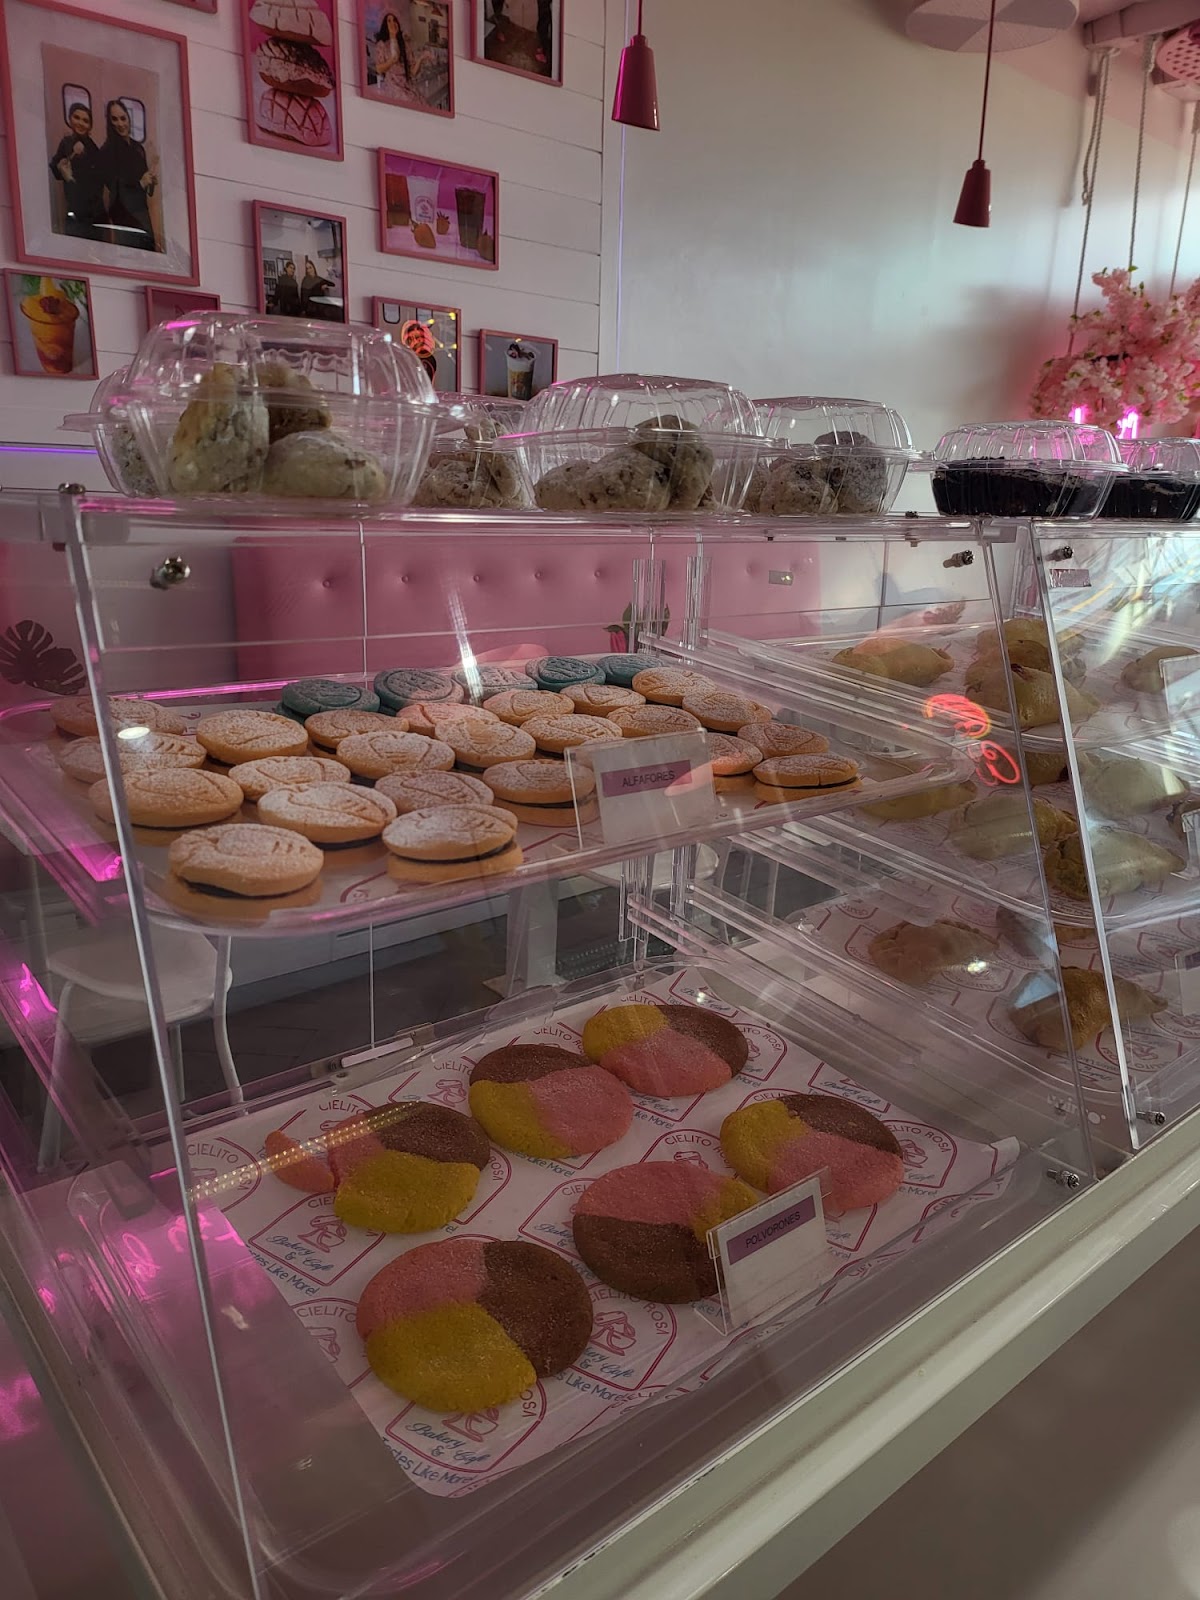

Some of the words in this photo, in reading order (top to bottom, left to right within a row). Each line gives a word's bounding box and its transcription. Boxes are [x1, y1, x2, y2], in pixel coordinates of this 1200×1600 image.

[622, 770, 676, 788] ALFAFORES
[664, 1133, 712, 1147] CIELITO
[924, 1131, 953, 1153] ROSA
[186, 1142, 240, 1164] CIELITO
[546, 1159, 576, 1178] More!
[744, 1210, 801, 1249] POLVORONES
[265, 1234, 317, 1257] Bakery
[284, 1250, 298, 1261] &
[266, 1262, 290, 1281] Like
[286, 1274, 321, 1297] More!
[642, 1302, 671, 1336] ROSA
[579, 1358, 593, 1370] &
[565, 1372, 591, 1392] Like
[519, 1389, 538, 1418] OSA
[404, 1422, 467, 1450] Bakery
[430, 1445, 444, 1457] &
[411, 1461, 439, 1480] Like
[438, 1471, 479, 1484] More!
